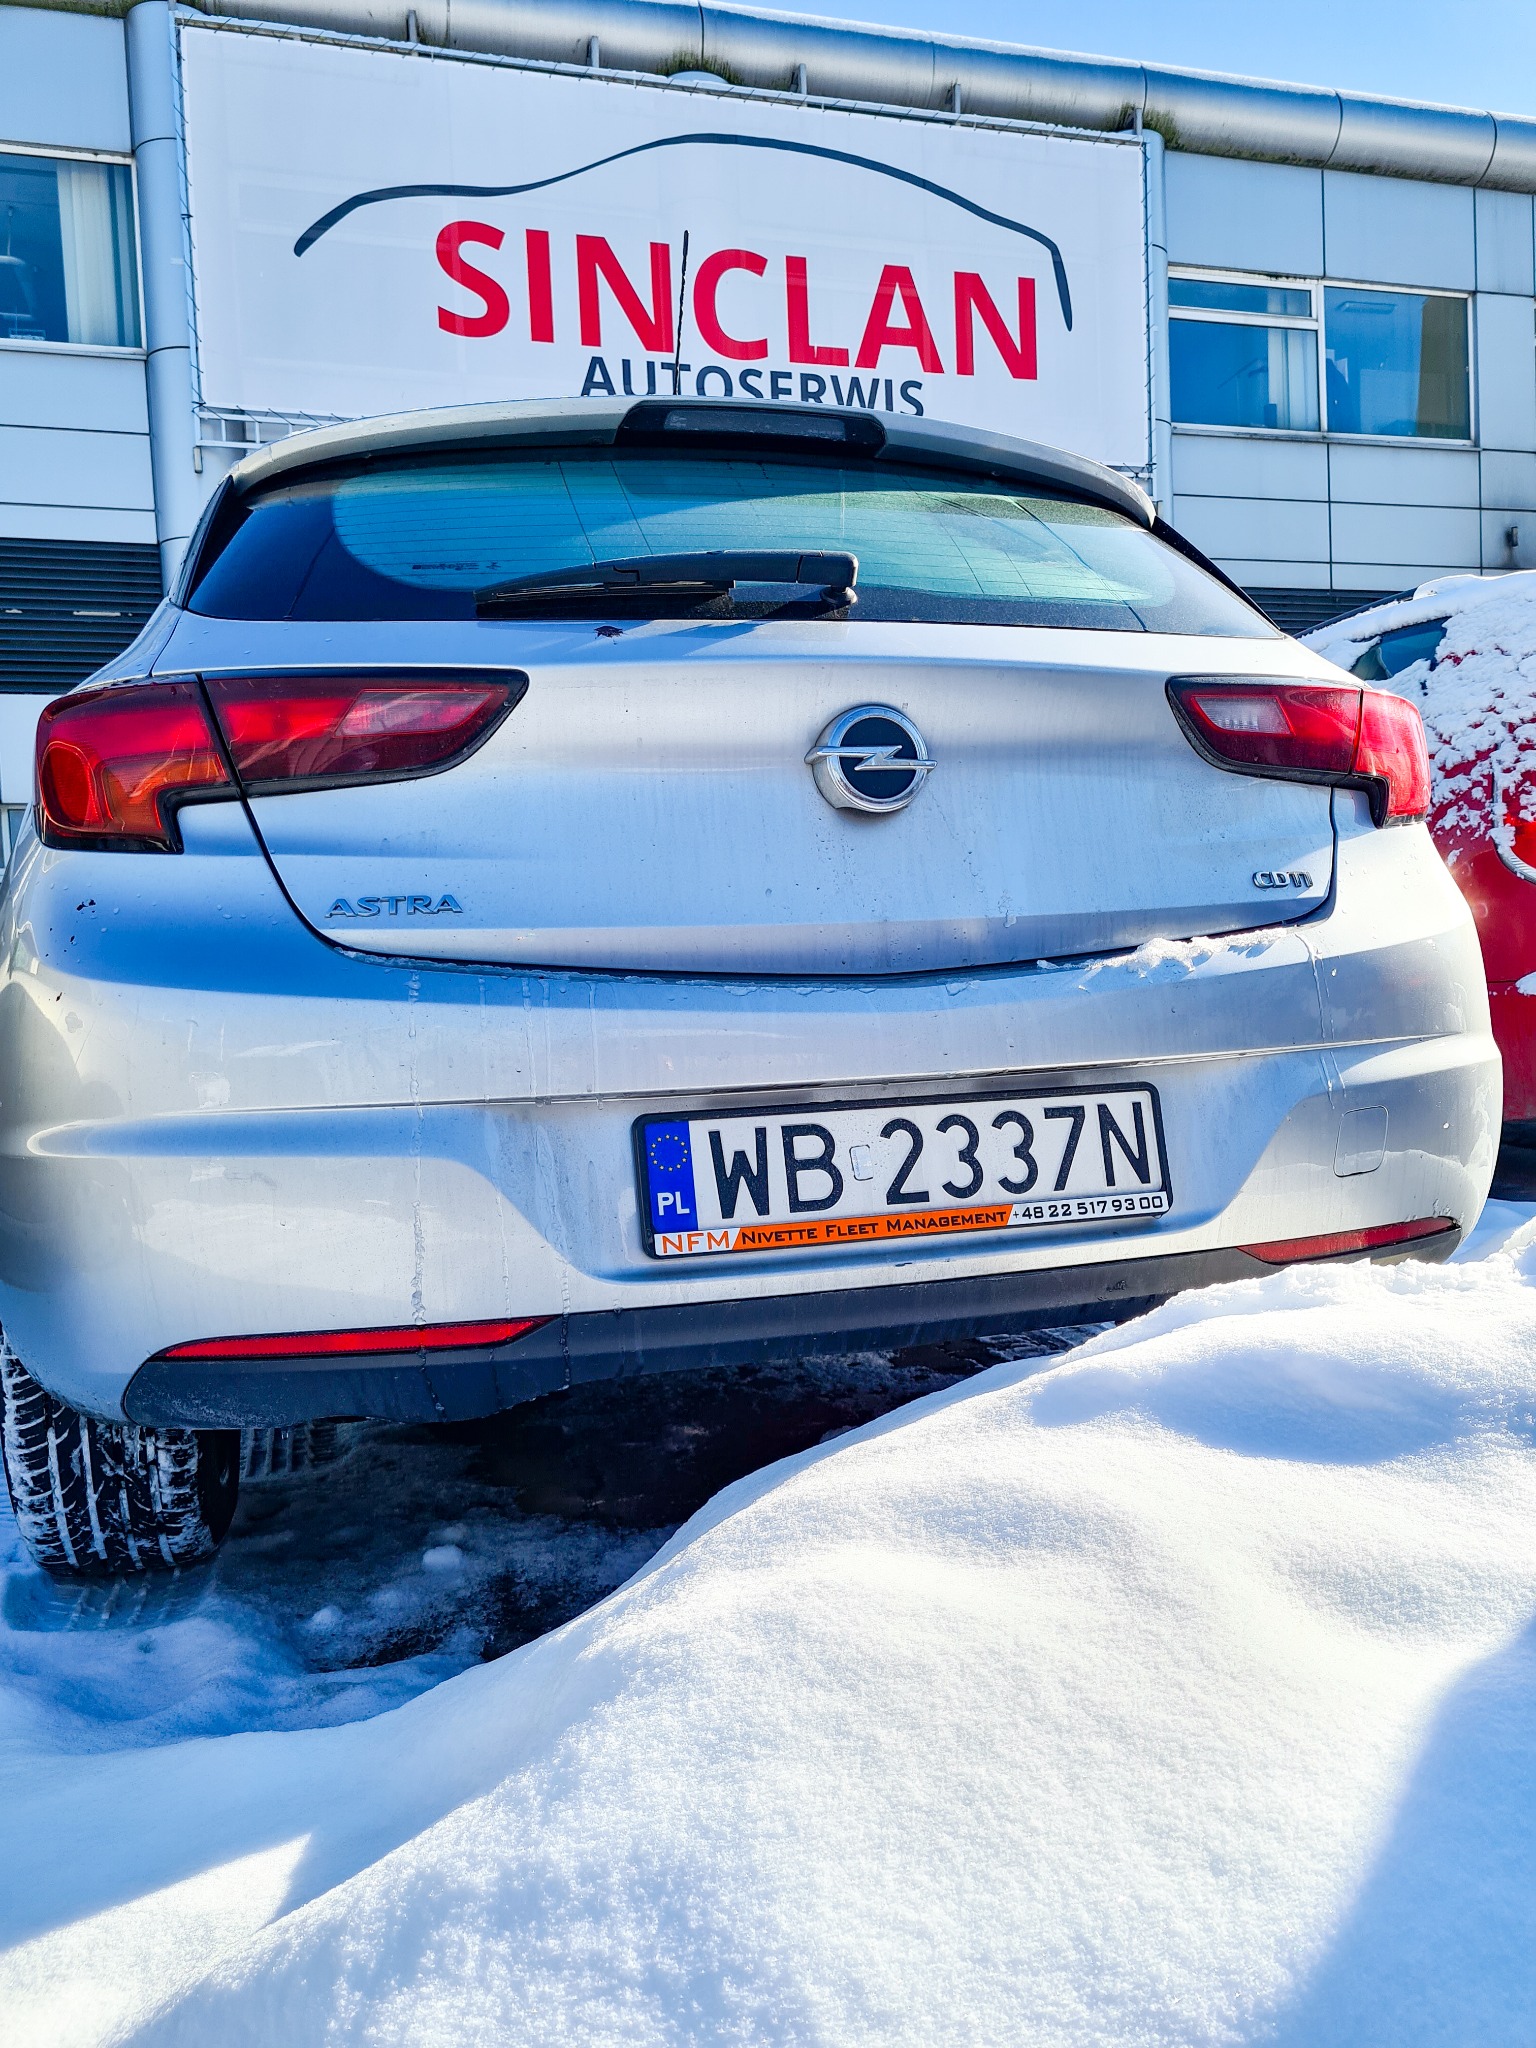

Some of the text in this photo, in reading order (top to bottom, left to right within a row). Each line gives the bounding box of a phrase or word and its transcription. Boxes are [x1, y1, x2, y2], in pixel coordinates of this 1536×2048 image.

[435, 220, 1038, 381] SINCLAN
[325, 894, 463, 918] ASTRA
[708, 1102, 1151, 1219] WB 2337N
[657, 1191, 690, 1216] PL
[662, 1231, 730, 1254] NFM
[1012, 1206, 1044, 1220] +48
[1048, 1203, 1072, 1218] 22
[1077, 1200, 1107, 1215] 517
[1111, 1198, 1136, 1212] 93
[1138, 1195, 1163, 1210] 00
